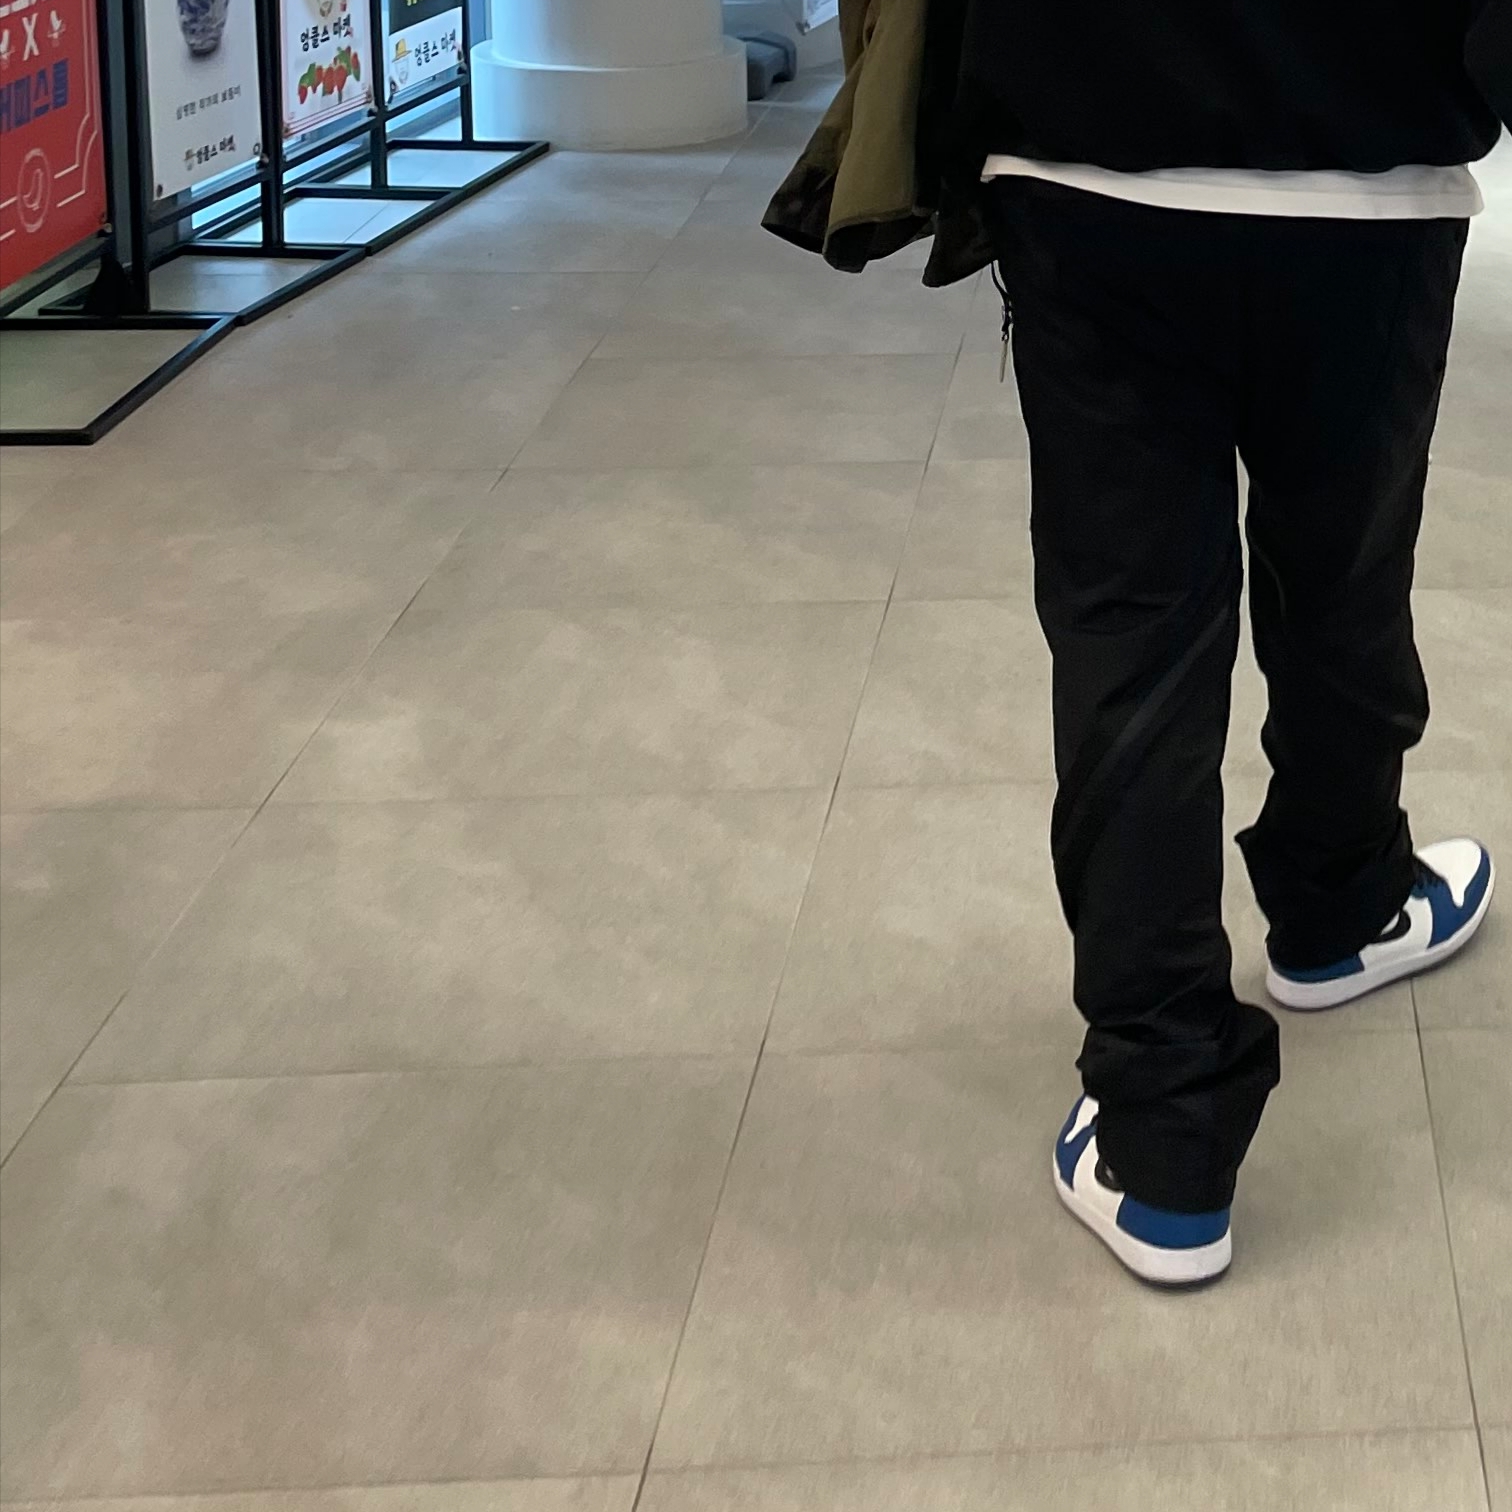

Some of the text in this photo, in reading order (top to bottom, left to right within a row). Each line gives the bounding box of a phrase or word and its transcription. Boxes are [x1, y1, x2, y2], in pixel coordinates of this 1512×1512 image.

[300, 12, 355, 52] 엉클스 마켓
[440, 28, 458, 56] 마켓
